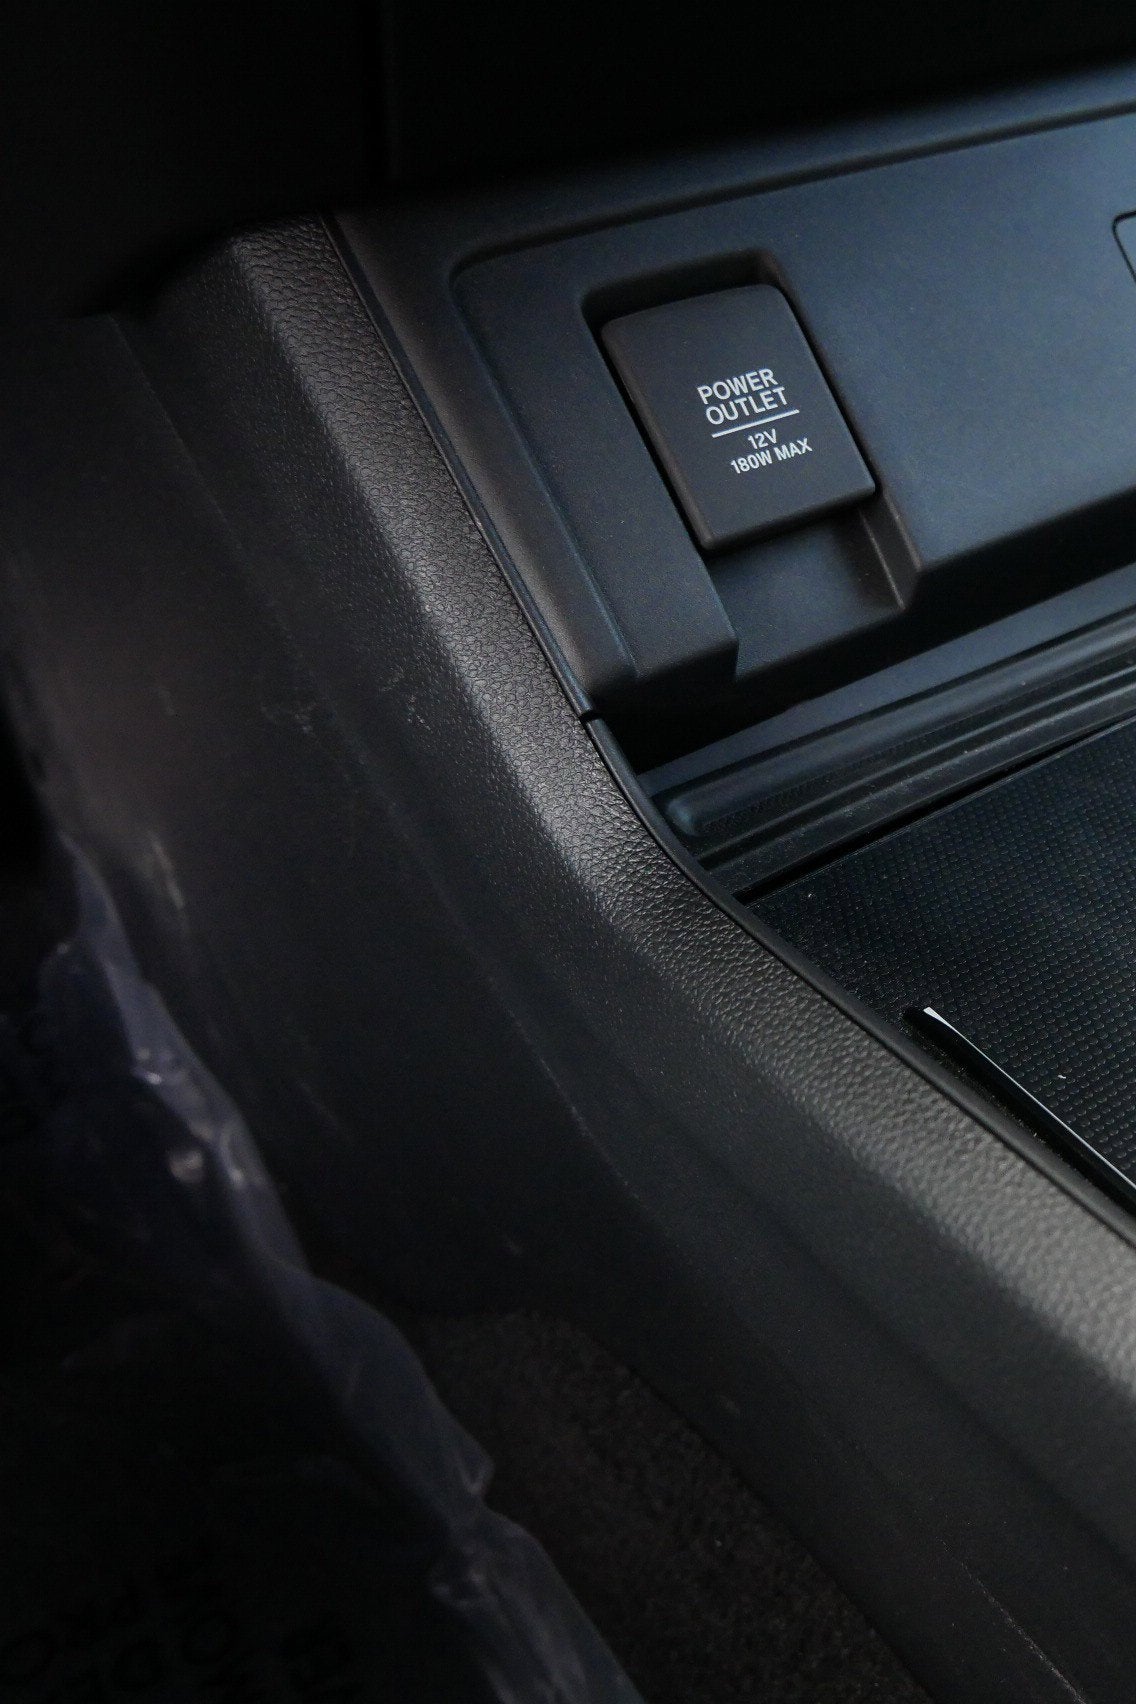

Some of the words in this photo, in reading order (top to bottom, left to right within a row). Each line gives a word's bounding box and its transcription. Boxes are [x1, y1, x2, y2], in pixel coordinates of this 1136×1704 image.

[697, 368, 778, 405] POWER
[705, 386, 788, 425] OUTLET
[730, 450, 773, 474] 180W
[774, 437, 813, 461] MAX
[748, 428, 777, 449] 12V
